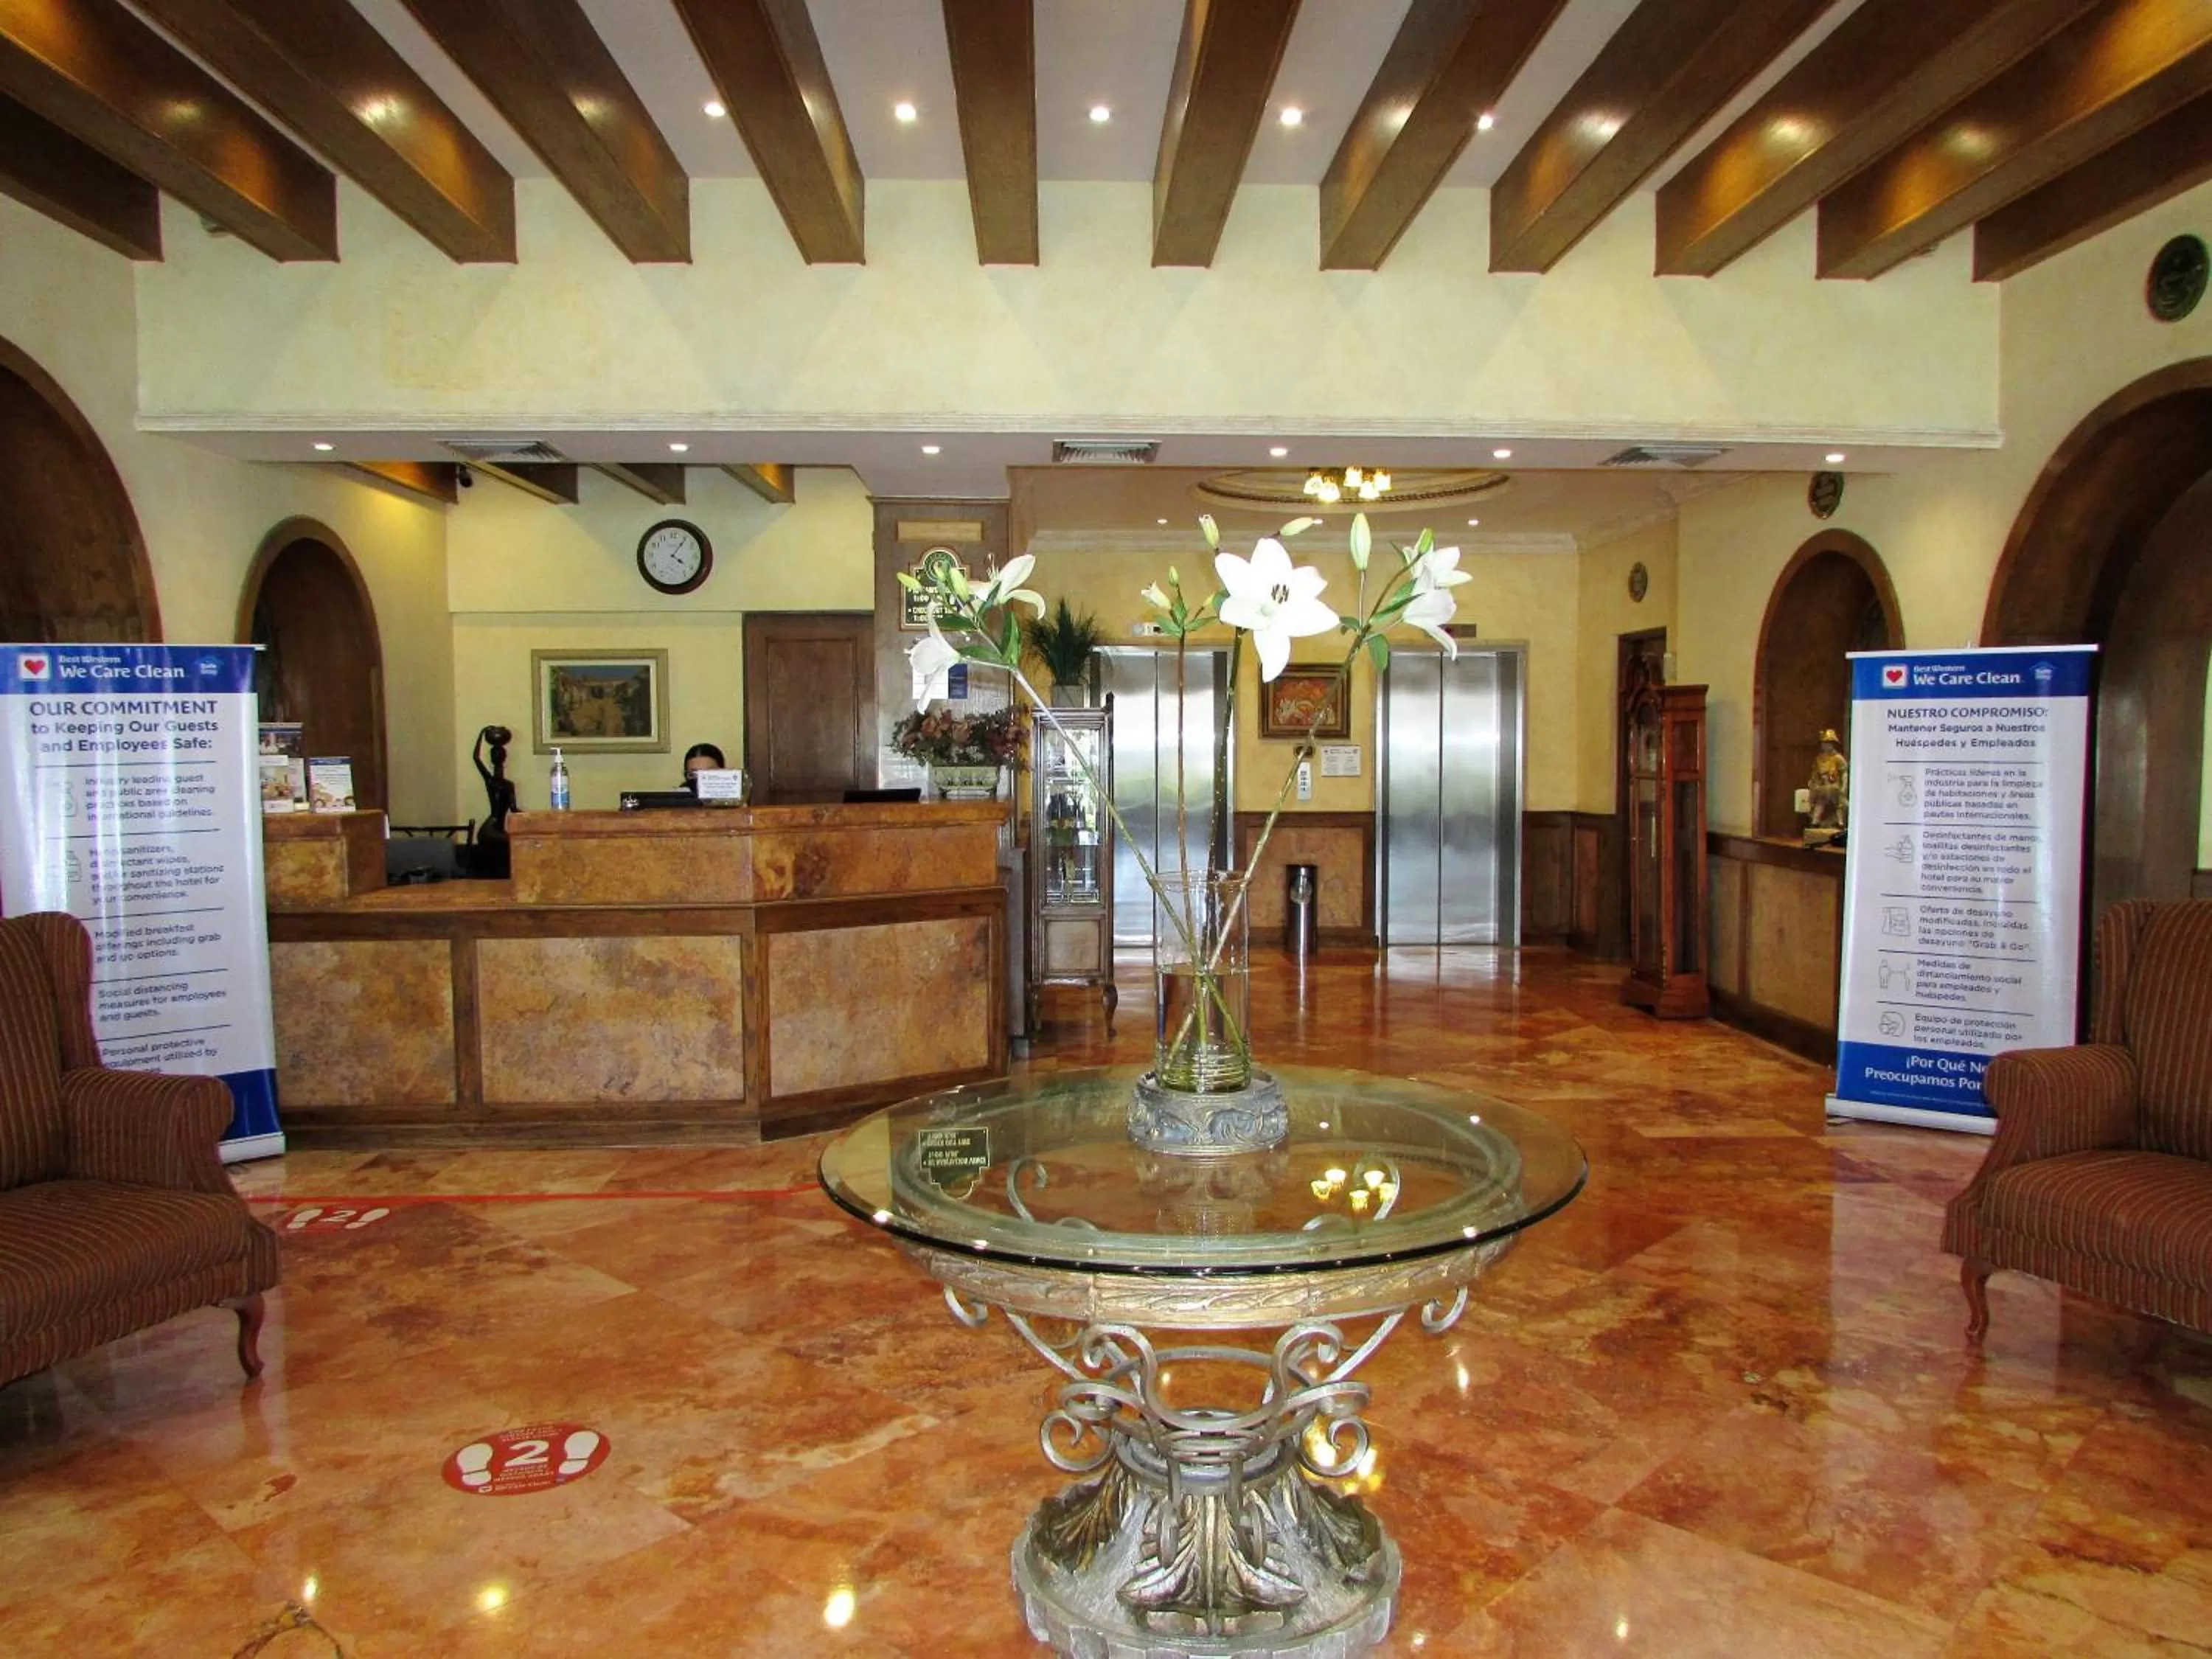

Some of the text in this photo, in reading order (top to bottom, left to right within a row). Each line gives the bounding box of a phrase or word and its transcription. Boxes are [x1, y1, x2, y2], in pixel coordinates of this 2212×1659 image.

[60, 665, 87, 678] We
[90, 665, 131, 678] Care
[135, 664, 185, 678] Clean
[1913, 674, 1935, 685] We
[1938, 673, 1973, 685] Care
[1976, 672, 2021, 684] Clean
[29, 700, 218, 716] OUR COMMITMENT
[1887, 707, 2049, 719] NUESTRO COMPROMISO:
[31, 720, 218, 735] to Keeping Our Guests
[1888, 724, 1936, 733] Mantener
[1940, 723, 1983, 734] Seguros
[1996, 723, 2046, 732] Nuestros
[41, 737, 212, 754] and Employees Safe:
[1961, 740, 1966, 748] y
[1971, 738, 2037, 748] Empleados
[175, 774, 204, 783] guest
[1924, 778, 1965, 787] industria
[1967, 779, 1989, 788] para
[1991, 779, 1999, 787] la
[1924, 789, 1936, 797] de
[1939, 789, 1997, 798] habitaciones
[1922, 831, 1992, 841] Desinfectantes
[1994, 833, 2006, 841] de
[1941, 852, 1990, 861] estaciones
[175, 877, 202, 886] hotel
[204, 876, 220, 884] for
[1921, 872, 1945, 881] hotel
[1952, 907, 1964, 915] de
[145, 924, 195, 936] breakfast
[1918, 926, 1931, 934] las
[147, 936, 195, 947] including
[198, 933, 221, 944] grab
[1917, 959, 1971, 970] Medidas de
[1916, 970, 1992, 982] distanciamiento
[98, 983, 189, 998] Social distancing
[1916, 981, 1937, 989] para
[1939, 981, 1992, 993] empleados
[99, 990, 226, 1009] measures for employees
[100, 1012, 121, 1022] and
[1915, 1012, 1947, 1023] Equipo
[1950, 1016, 1962, 1024] de
[1913, 1024, 1957, 1035] personal
[1913, 1034, 1927, 1043] los
[102, 1038, 205, 1056] Personal protective
[205, 1048, 218, 1057] by
[1937, 1057, 1966, 1073] Qué
[1865, 1067, 1983, 1091] Preocupamos Por
[505, 1439, 549, 1467] 2
